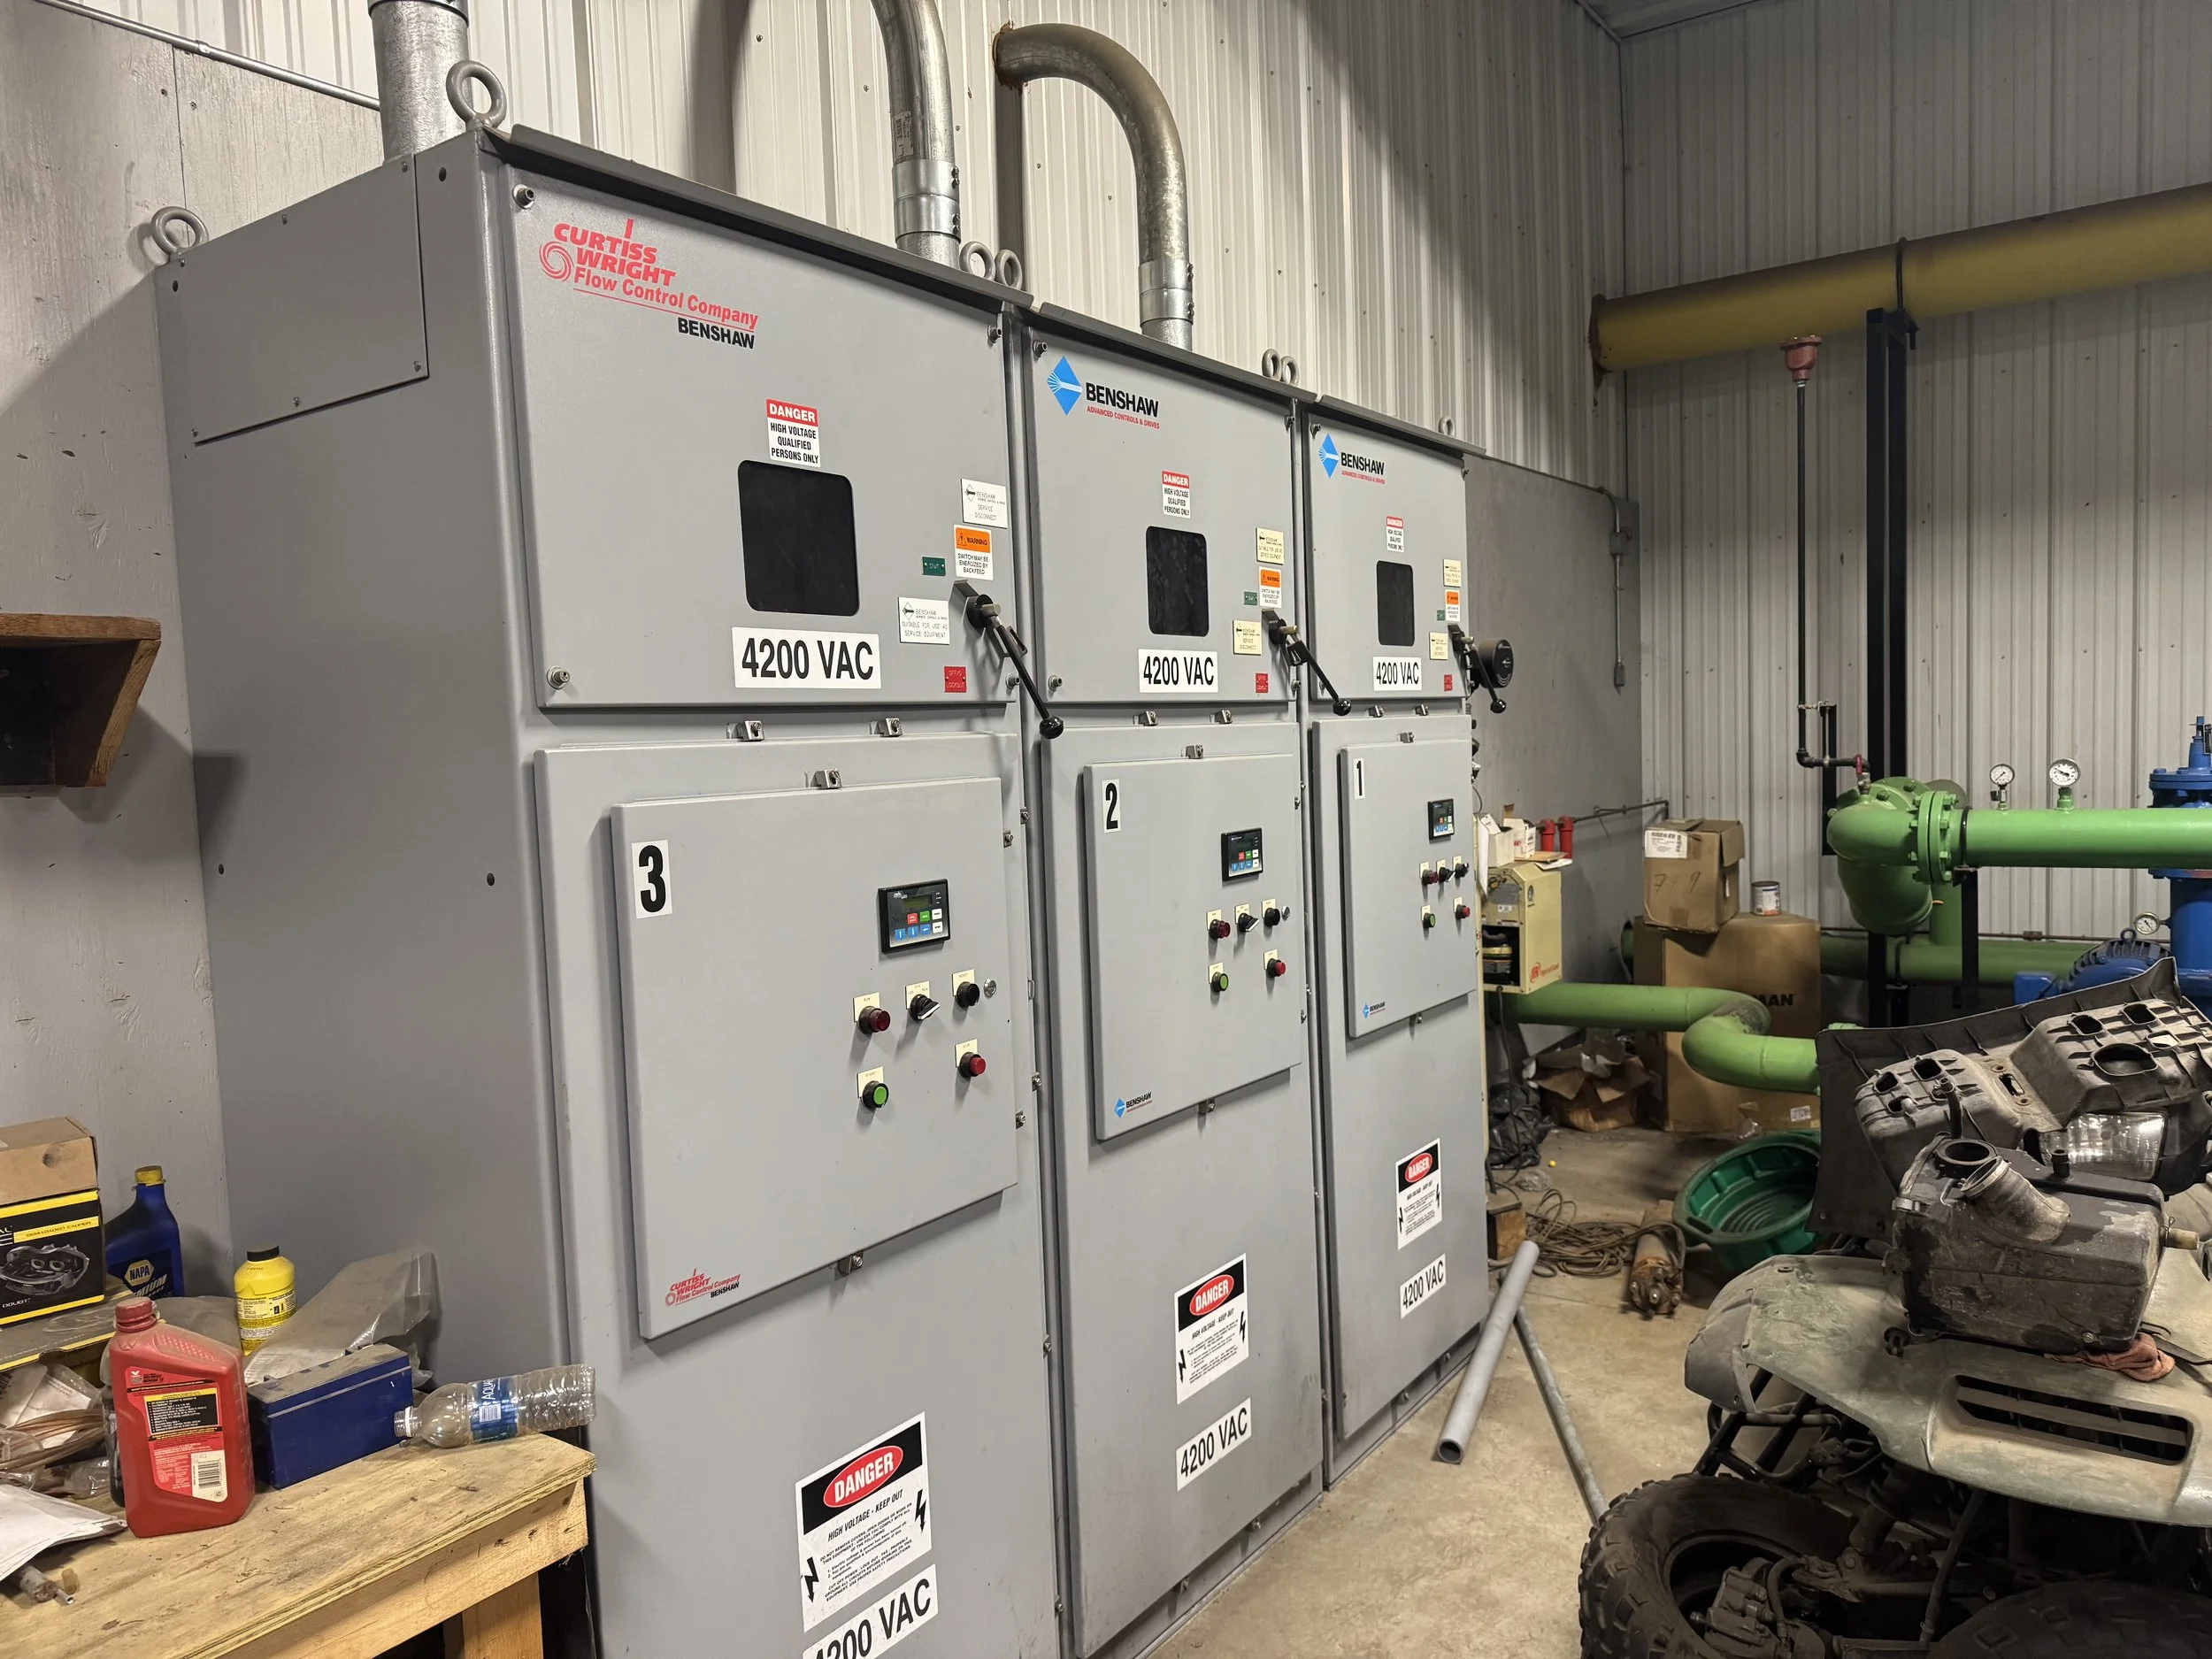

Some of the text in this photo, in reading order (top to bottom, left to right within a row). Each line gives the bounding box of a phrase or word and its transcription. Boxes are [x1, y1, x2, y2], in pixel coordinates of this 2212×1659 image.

[554, 219, 657, 264] CURTISS
[577, 248, 675, 286] WRIGHT
[574, 267, 758, 329] Flow Control Company
[678, 317, 755, 349] BENSHAW
[769, 403, 816, 423] DANGER
[1086, 382, 1159, 418] BENSHAW
[771, 422, 817, 439] HIGH VOLTAGE
[1087, 406, 1113, 418] ADVANCED
[1115, 412, 1139, 424] CONTROLS
[1144, 419, 1160, 429] DRIVES
[772, 447, 818, 464] PERSONS ONLY
[778, 436, 811, 450] QUALIFIED
[1340, 452, 1385, 475] BENSHAW
[1164, 473, 1188, 487] DANGER
[966, 537, 987, 546] WARNING
[741, 637, 873, 680] 4200 VAC
[1143, 656, 1214, 686] 4200 VAC
[1376, 662, 1419, 685] 4200 VAC
[1356, 760, 1363, 796] 1
[1105, 782, 1118, 830] 2
[638, 844, 666, 913] 3
[1126, 1092, 1151, 1108] BENSHAW
[129, 1265, 150, 1280] NAPA
[670, 1268, 705, 1292] CURTISS
[677, 1277, 711, 1295] WRIGHT
[1403, 1260, 1444, 1310] 4200 VAC
[676, 1274, 741, 1302] Flow Control Company
[710, 1282, 740, 1298] BENSHAW
[1195, 1279, 1229, 1313] DANGER
[1180, 1407, 1248, 1478] 4200 VAC
[834, 1451, 895, 1503] DANGER
[828, 1525, 843, 1542] HIGH
[844, 1509, 870, 1532] VOLTAGE
[875, 1497, 890, 1513] KEEP
[891, 1489, 902, 1503] OUT
[814, 1578, 931, 1658] 200 VAC
